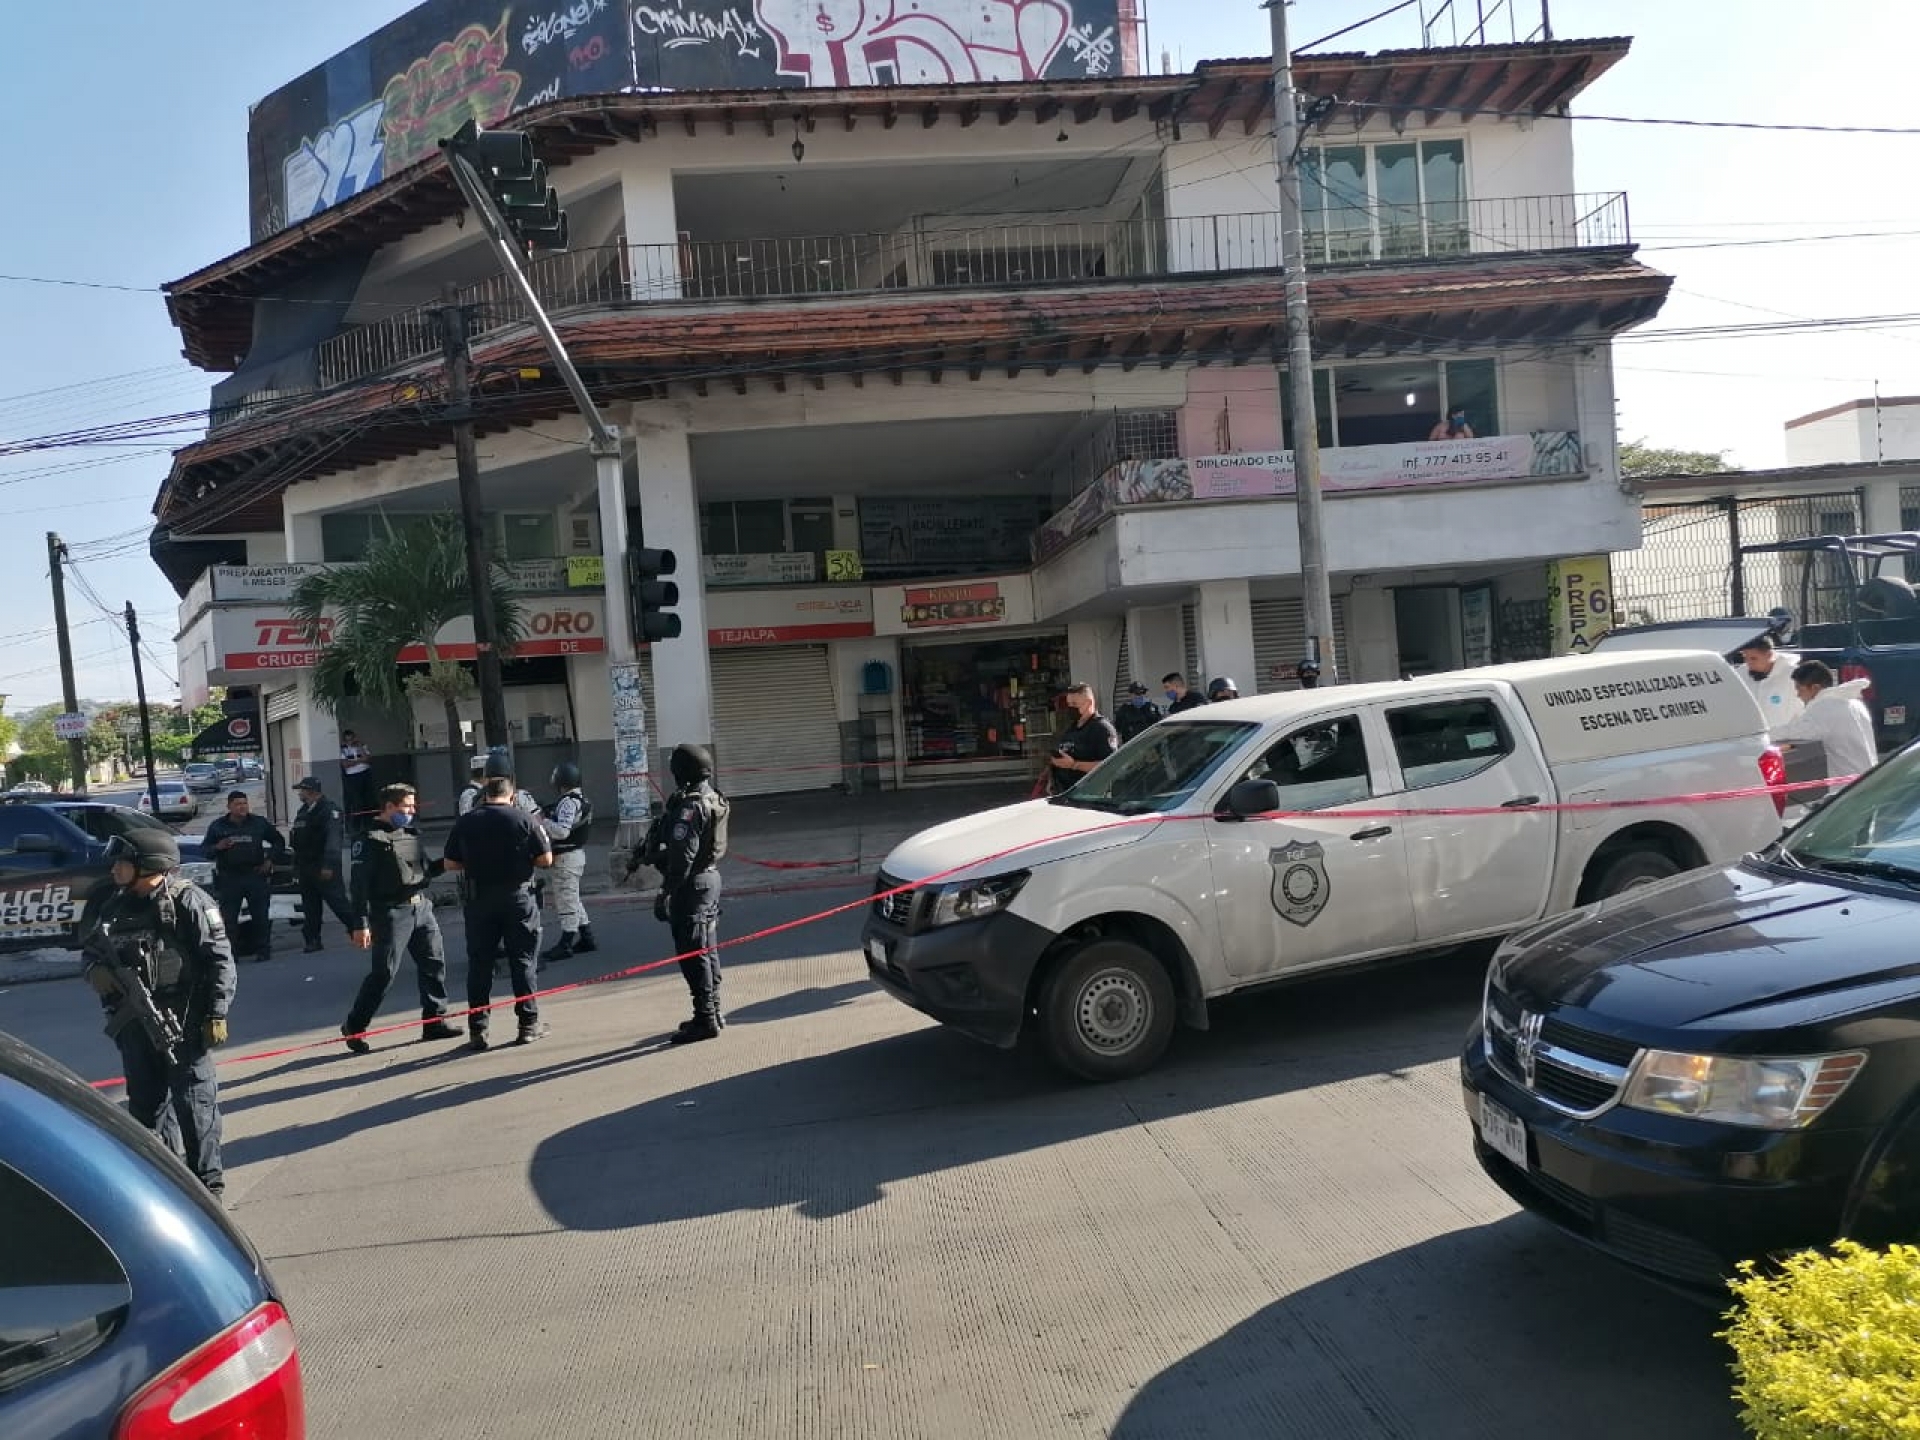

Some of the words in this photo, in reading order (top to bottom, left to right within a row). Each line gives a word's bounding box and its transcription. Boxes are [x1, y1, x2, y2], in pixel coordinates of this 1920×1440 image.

[1197, 457, 1264, 468] DIPLOMADO
[1269, 455, 1283, 463] EN
[1424, 456, 1447, 467] 777
[1451, 454, 1471, 464] 413
[1475, 453, 1492, 462] 95
[219, 566, 305, 577] PREPARATORIA
[252, 577, 286, 586] MESES
[1589, 589, 1606, 613] 6
[1567, 574, 1589, 649] PREPA
[530, 612, 594, 635] ORO
[719, 629, 776, 641] TEJALPA
[561, 642, 579, 652] DE
[1544, 688, 1592, 707] UNIDAD
[1593, 675, 1687, 700] ESPECIALIZADA
[1686, 673, 1704, 687] EN
[1705, 670, 1722, 684] LA
[1580, 711, 1632, 731] ESCENA
[1632, 707, 1658, 723] DEL
[1659, 700, 1708, 719] CRIMEN
